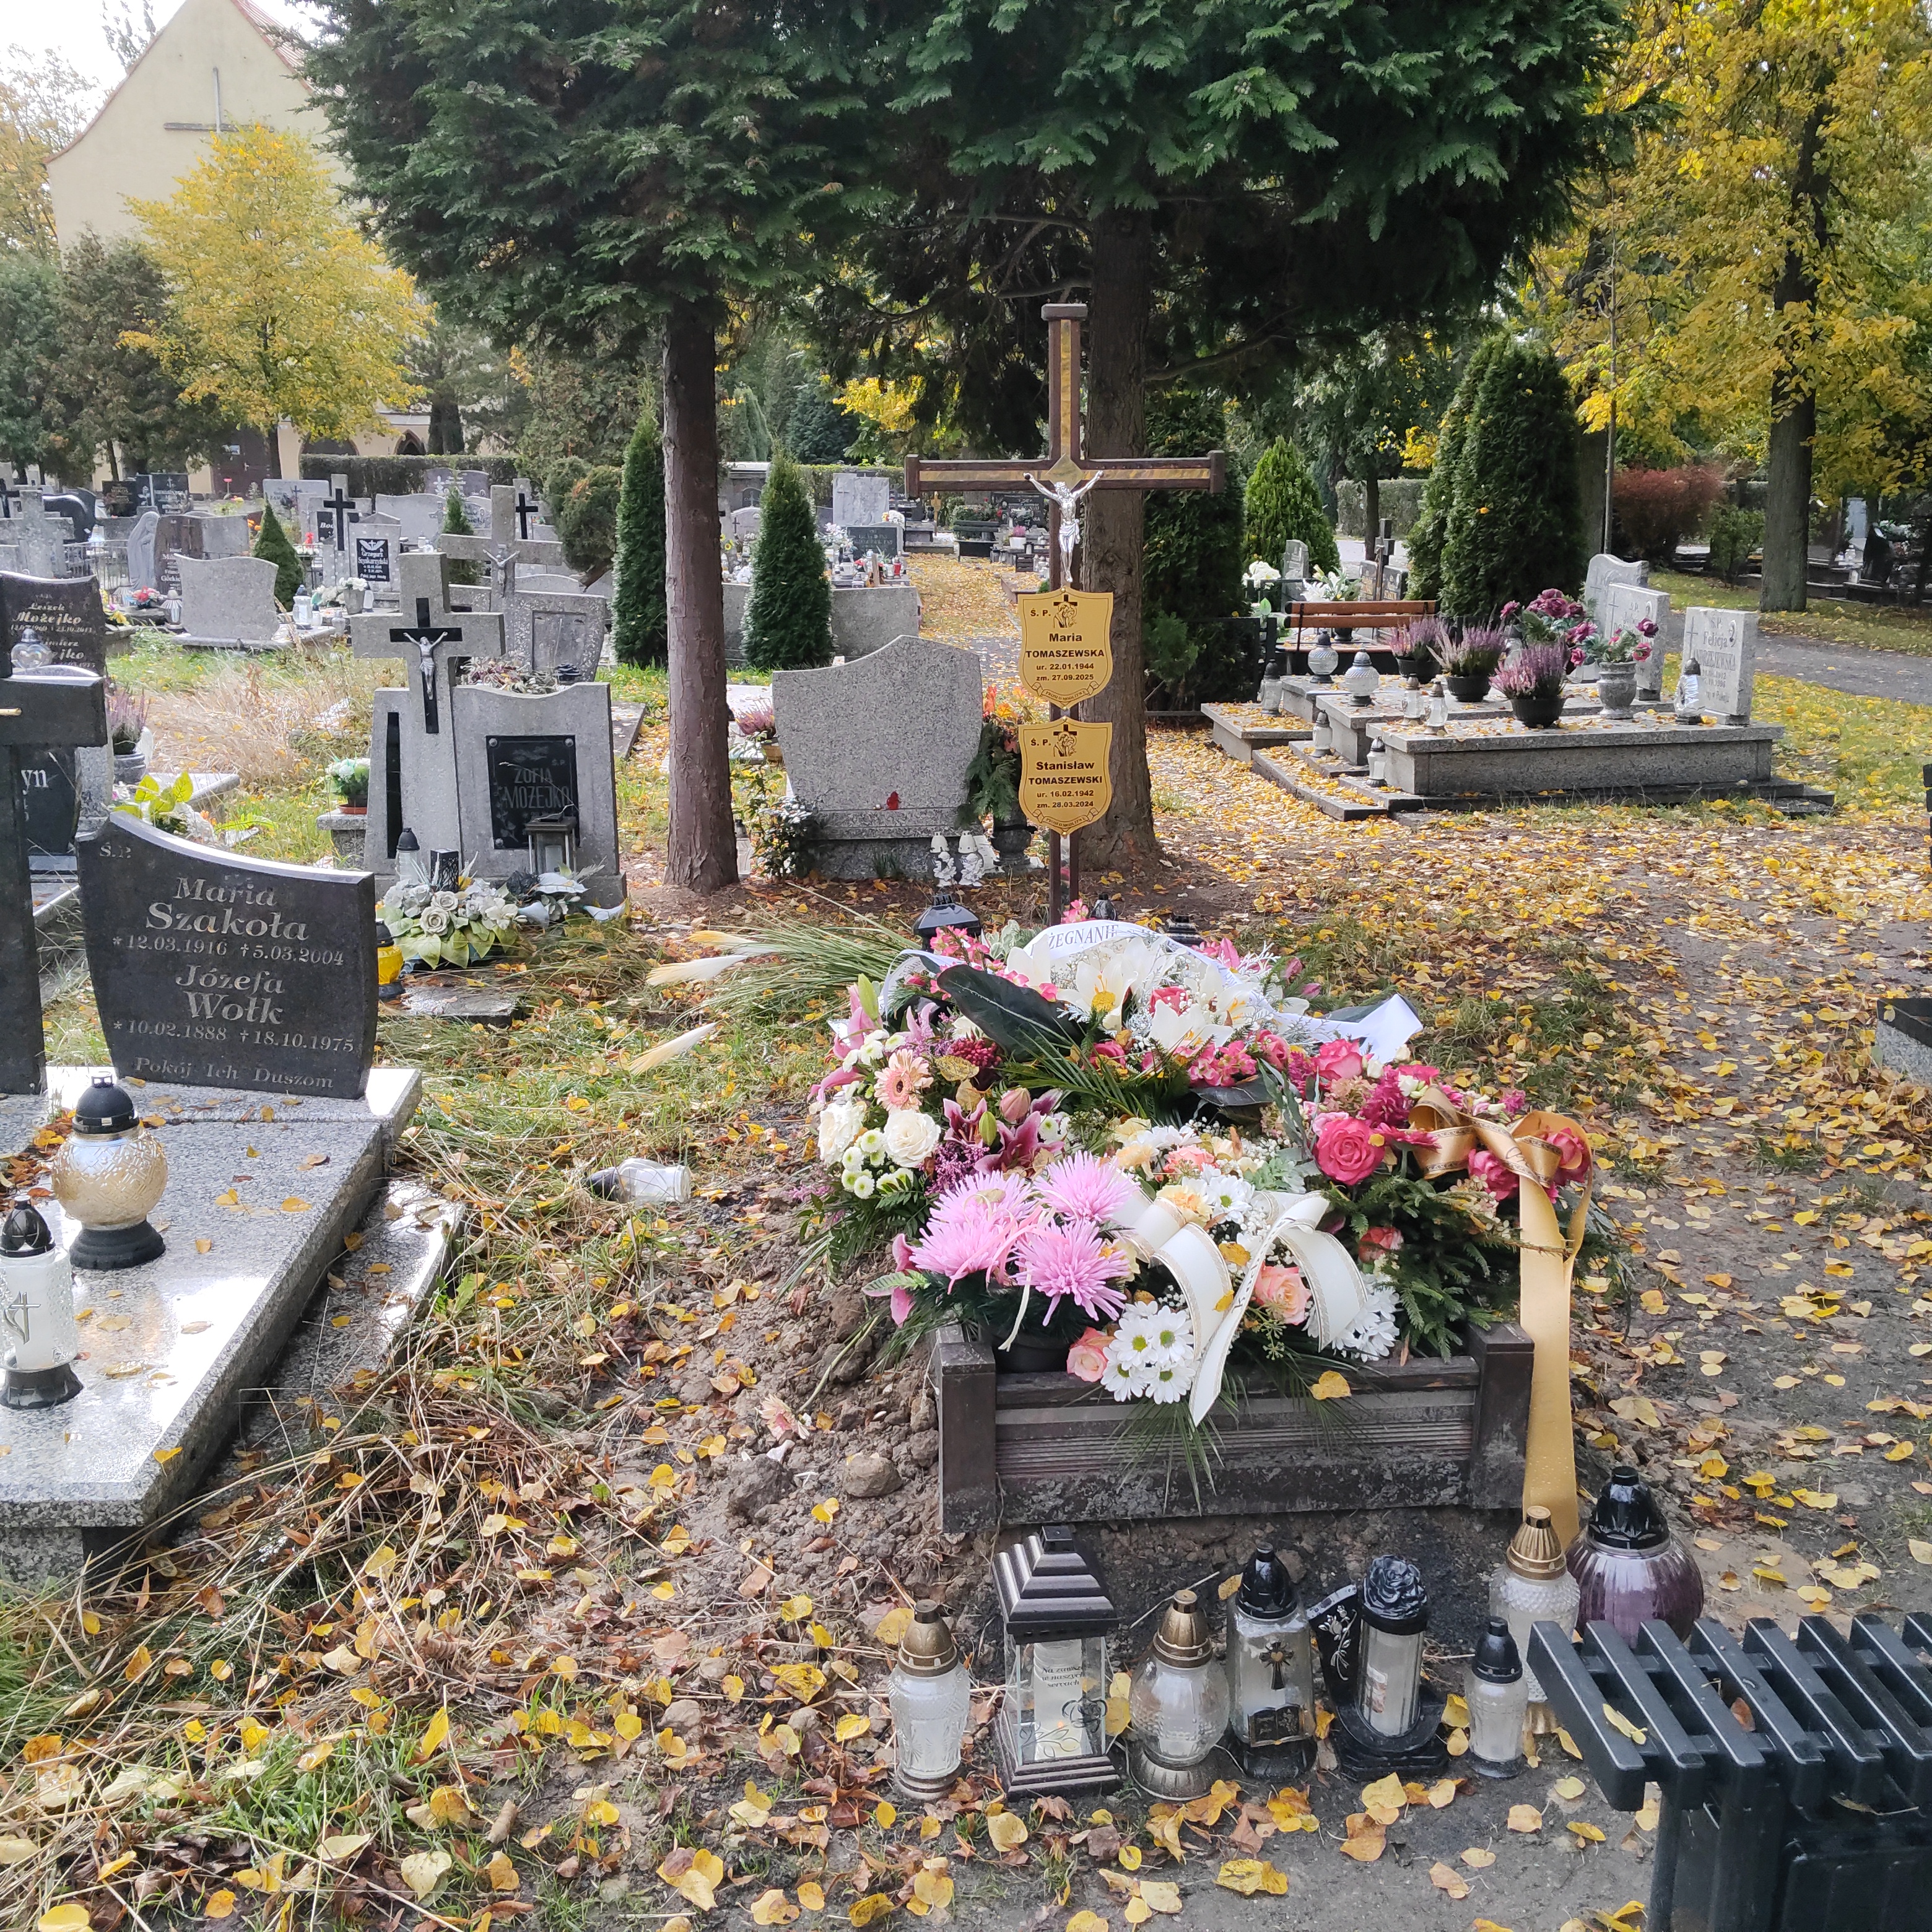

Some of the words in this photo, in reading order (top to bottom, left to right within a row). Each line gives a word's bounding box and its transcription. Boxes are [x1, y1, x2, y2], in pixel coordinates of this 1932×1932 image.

[1049, 633, 1082, 642] Maria
[1703, 631, 1729, 650] Felicja
[1026, 649, 1105, 658] TOMASZEWSKA
[1035, 760, 1095, 770] Stanisław
[513, 768, 553, 784] ZOFIA
[1028, 776, 1102, 785] TOMASZEWSKI
[1050, 790, 1094, 798] 16.02.1942
[173, 877, 278, 906] Maria
[146, 902, 309, 941] Szakoła
[175, 964, 285, 994] Józefa
[183, 991, 284, 1024] Wołk
[128, 1020, 227, 1041] 10.02.1888
[253, 1030, 354, 1052] 18.10.1975
[134, 1056, 192, 1079] Pokój
[207, 1063, 240, 1080] Ich
[252, 1067, 334, 1088] Duszom
